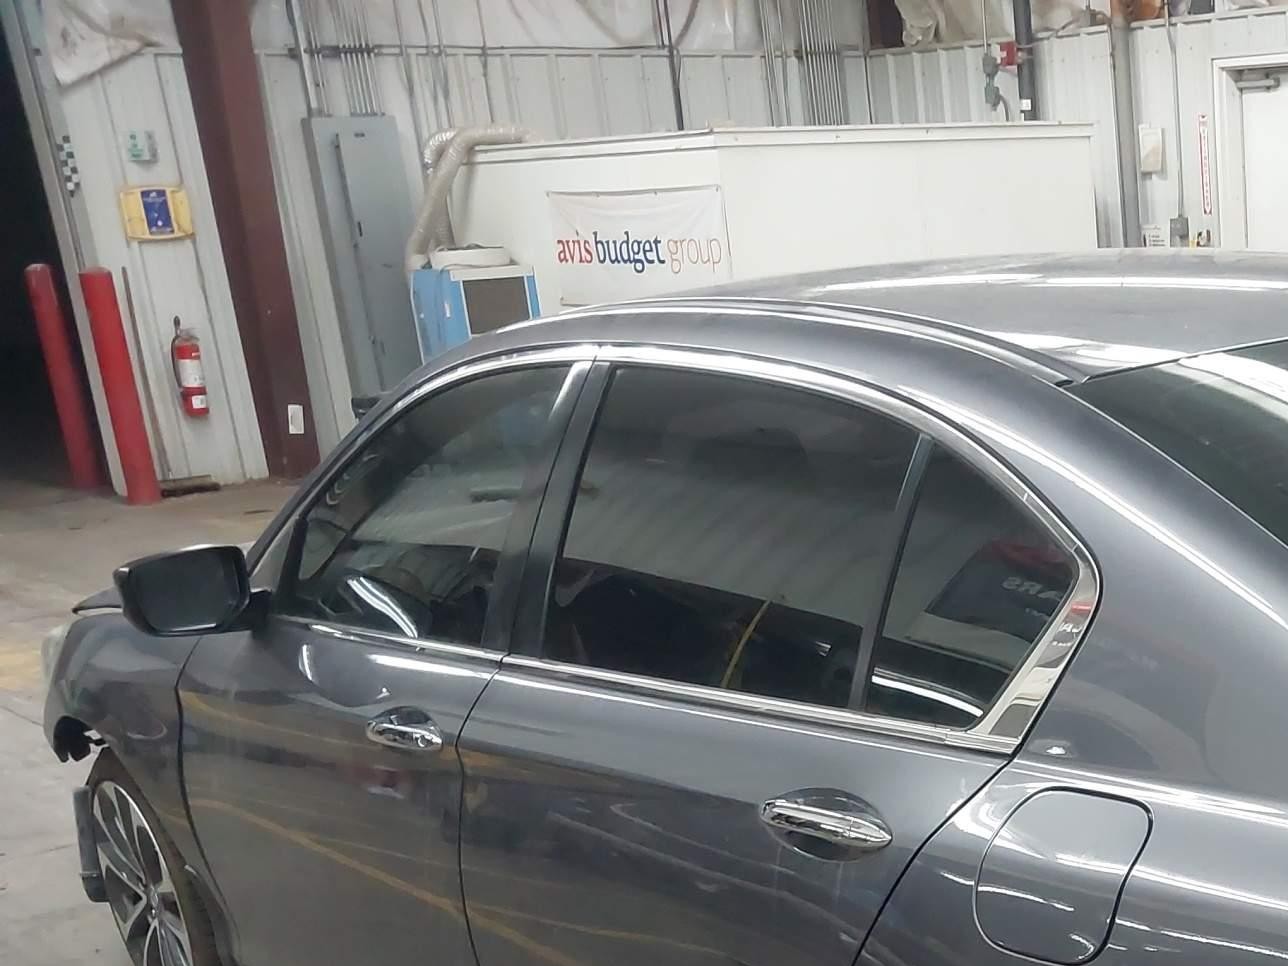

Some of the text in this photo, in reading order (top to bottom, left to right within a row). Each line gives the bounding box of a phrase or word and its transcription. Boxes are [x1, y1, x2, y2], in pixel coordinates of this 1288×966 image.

[556, 229, 722, 274] avis budget group
